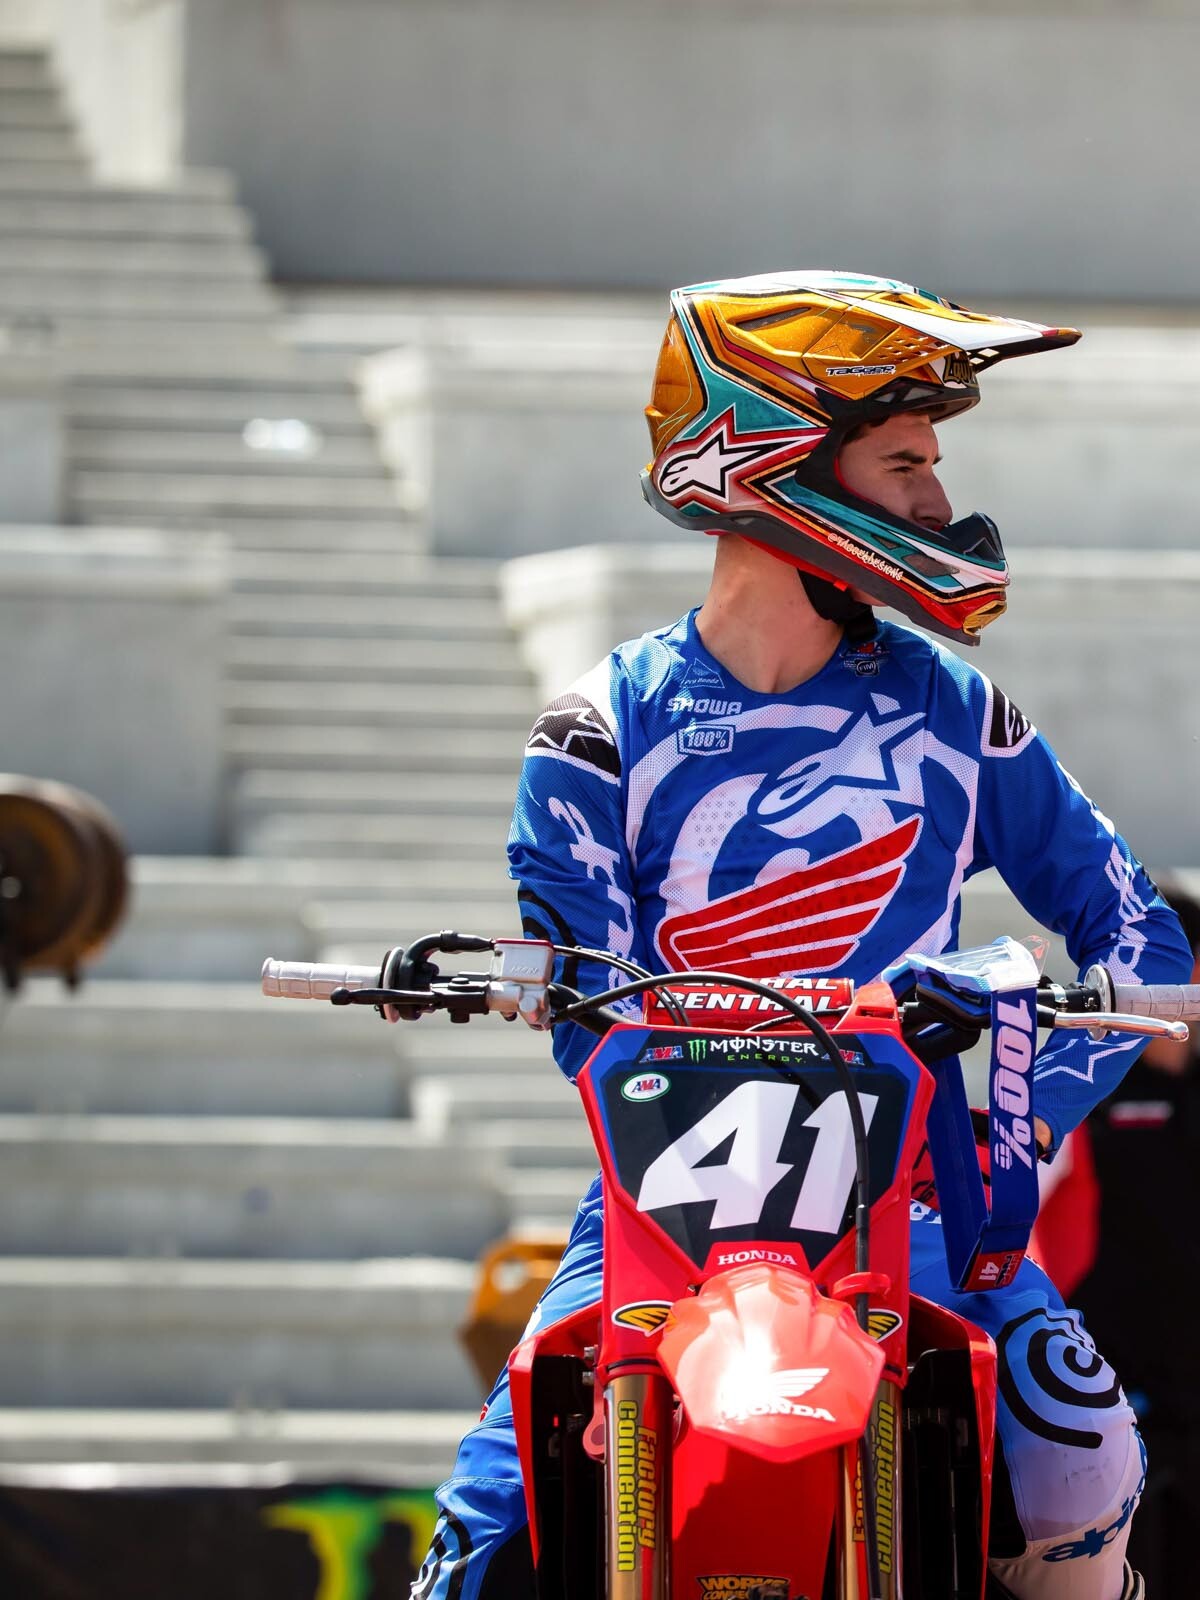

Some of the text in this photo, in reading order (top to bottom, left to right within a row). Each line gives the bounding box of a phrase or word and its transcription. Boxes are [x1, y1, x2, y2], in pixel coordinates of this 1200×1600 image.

[665, 697, 742, 716] SHOWA
[685, 731, 728, 750] 100%
[639, 1045, 684, 1064] AMA
[709, 1035, 819, 1057] MONSTER
[727, 1054, 804, 1064] ENERGY
[631, 1077, 662, 1094] AMA
[993, 998, 1033, 1171] 100%
[636, 1080, 879, 1235] 41
[717, 1249, 798, 1266] HONDA
[979, 1262, 1000, 1281] 41
[637, 1425, 658, 1549] Factory
